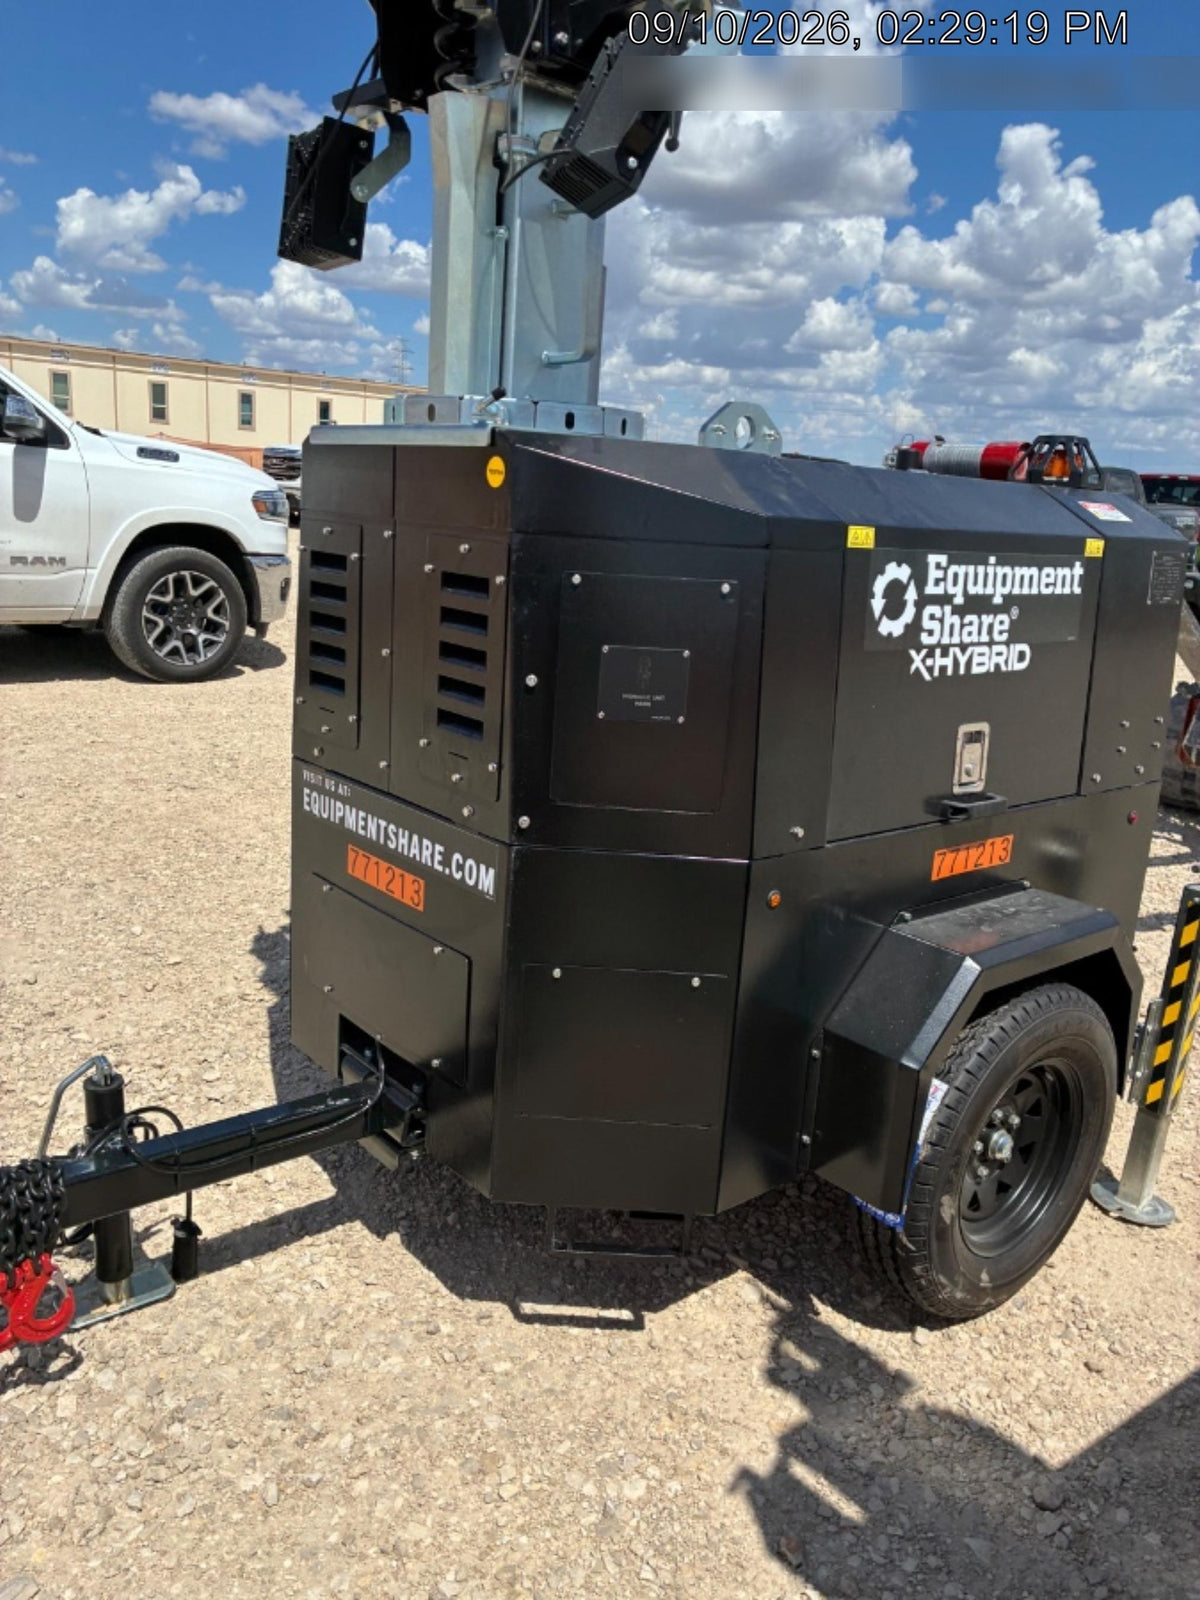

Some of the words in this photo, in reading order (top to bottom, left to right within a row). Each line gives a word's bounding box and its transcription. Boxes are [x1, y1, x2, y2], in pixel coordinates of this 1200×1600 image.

[10, 556, 66, 566] RAM
[924, 554, 1084, 605] Equipment
[908, 643, 1031, 681] X-HYBRID
[303, 769, 323, 787] VISIT
[325, 777, 335, 792] US
[338, 783, 351, 797] AT:
[303, 786, 495, 896] EQUIPMENTSHARE.COM
[936, 837, 1011, 877] 771213
[349, 848, 422, 908] 771213
